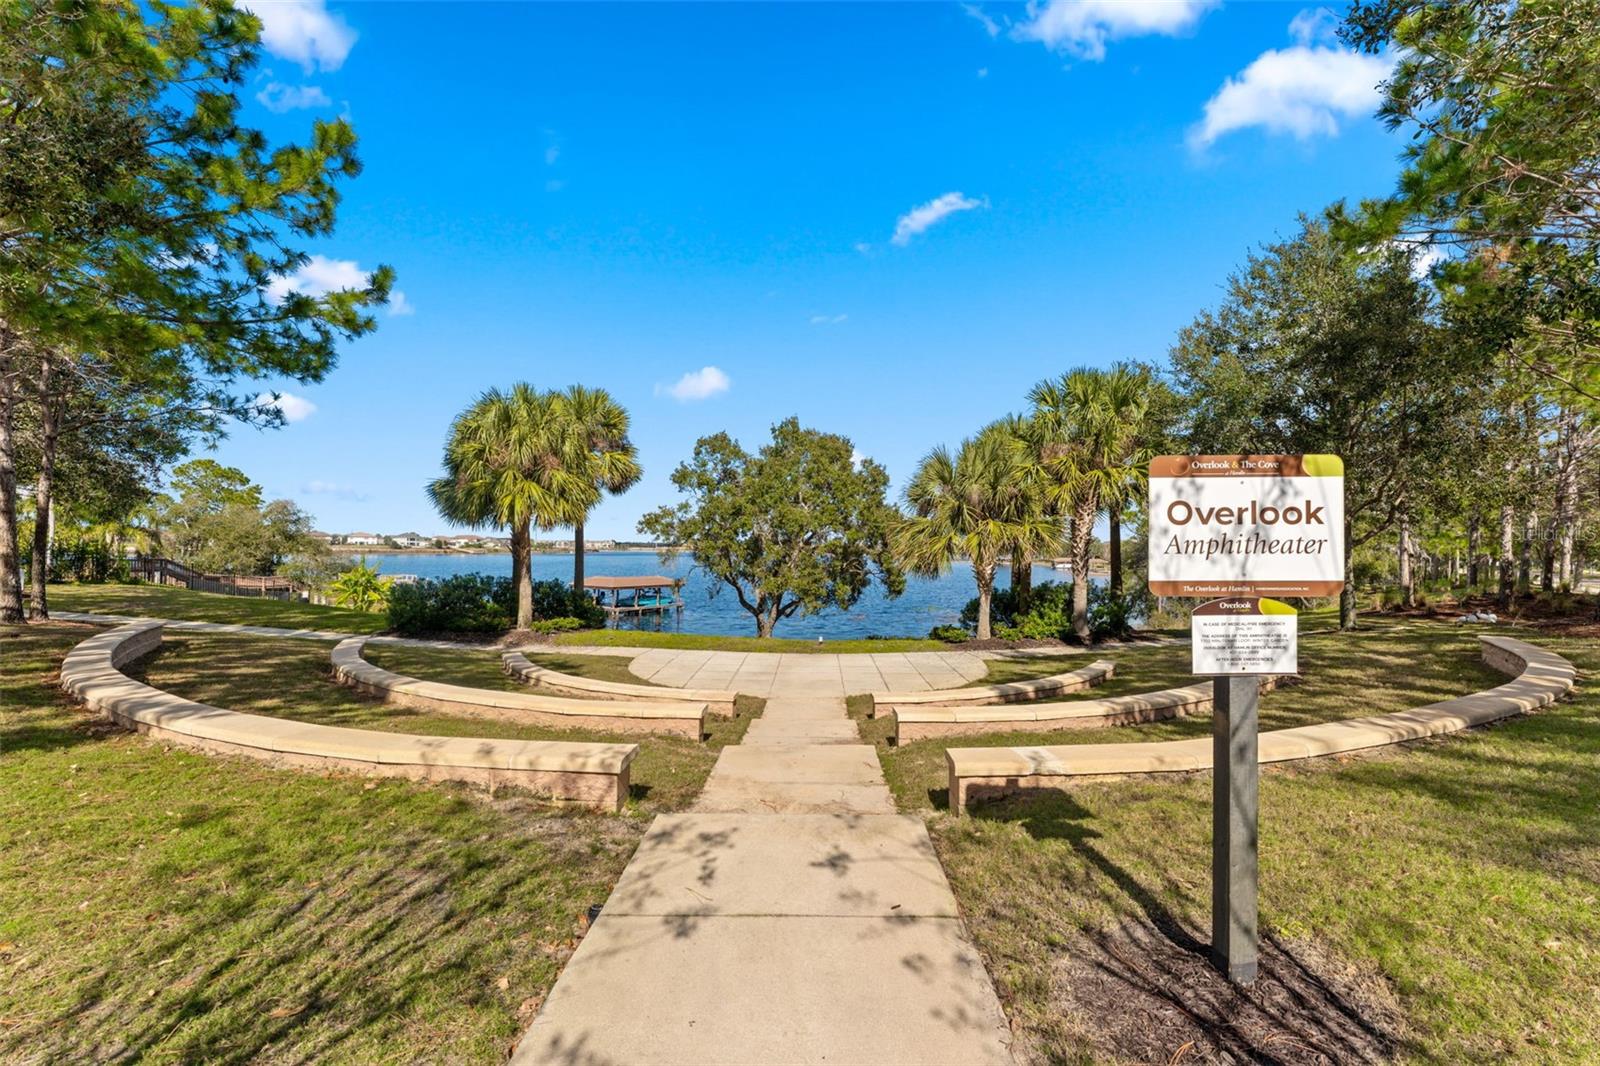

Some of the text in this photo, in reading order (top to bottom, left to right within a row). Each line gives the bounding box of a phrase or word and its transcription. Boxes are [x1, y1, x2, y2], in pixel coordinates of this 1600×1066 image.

[1191, 460, 1279, 469] Overlook & The Cove
[1167, 500, 1324, 526] Overlook
[1164, 532, 1328, 561] Amphitheater
